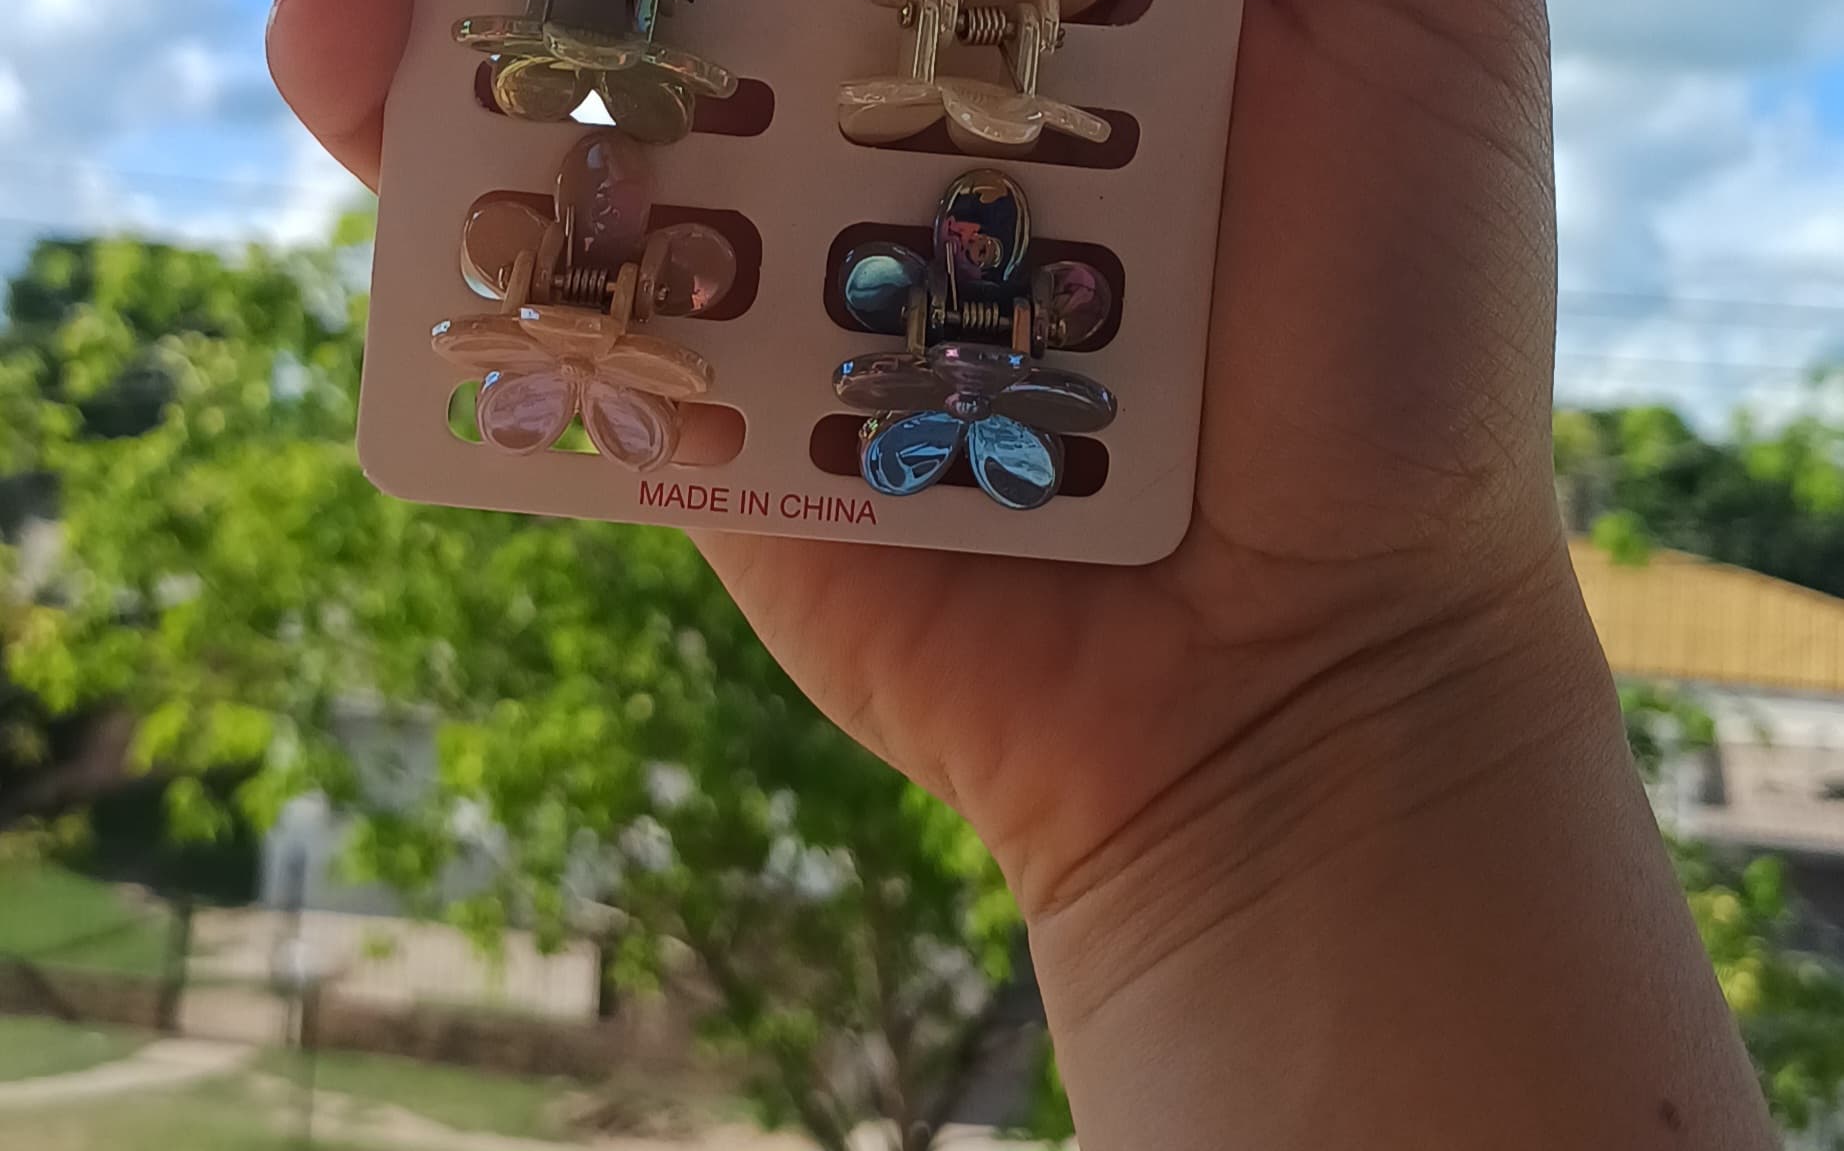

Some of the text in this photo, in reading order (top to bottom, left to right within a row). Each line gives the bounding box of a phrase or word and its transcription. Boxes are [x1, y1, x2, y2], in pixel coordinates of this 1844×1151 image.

[639, 480, 877, 525] MADE IN CHINA
